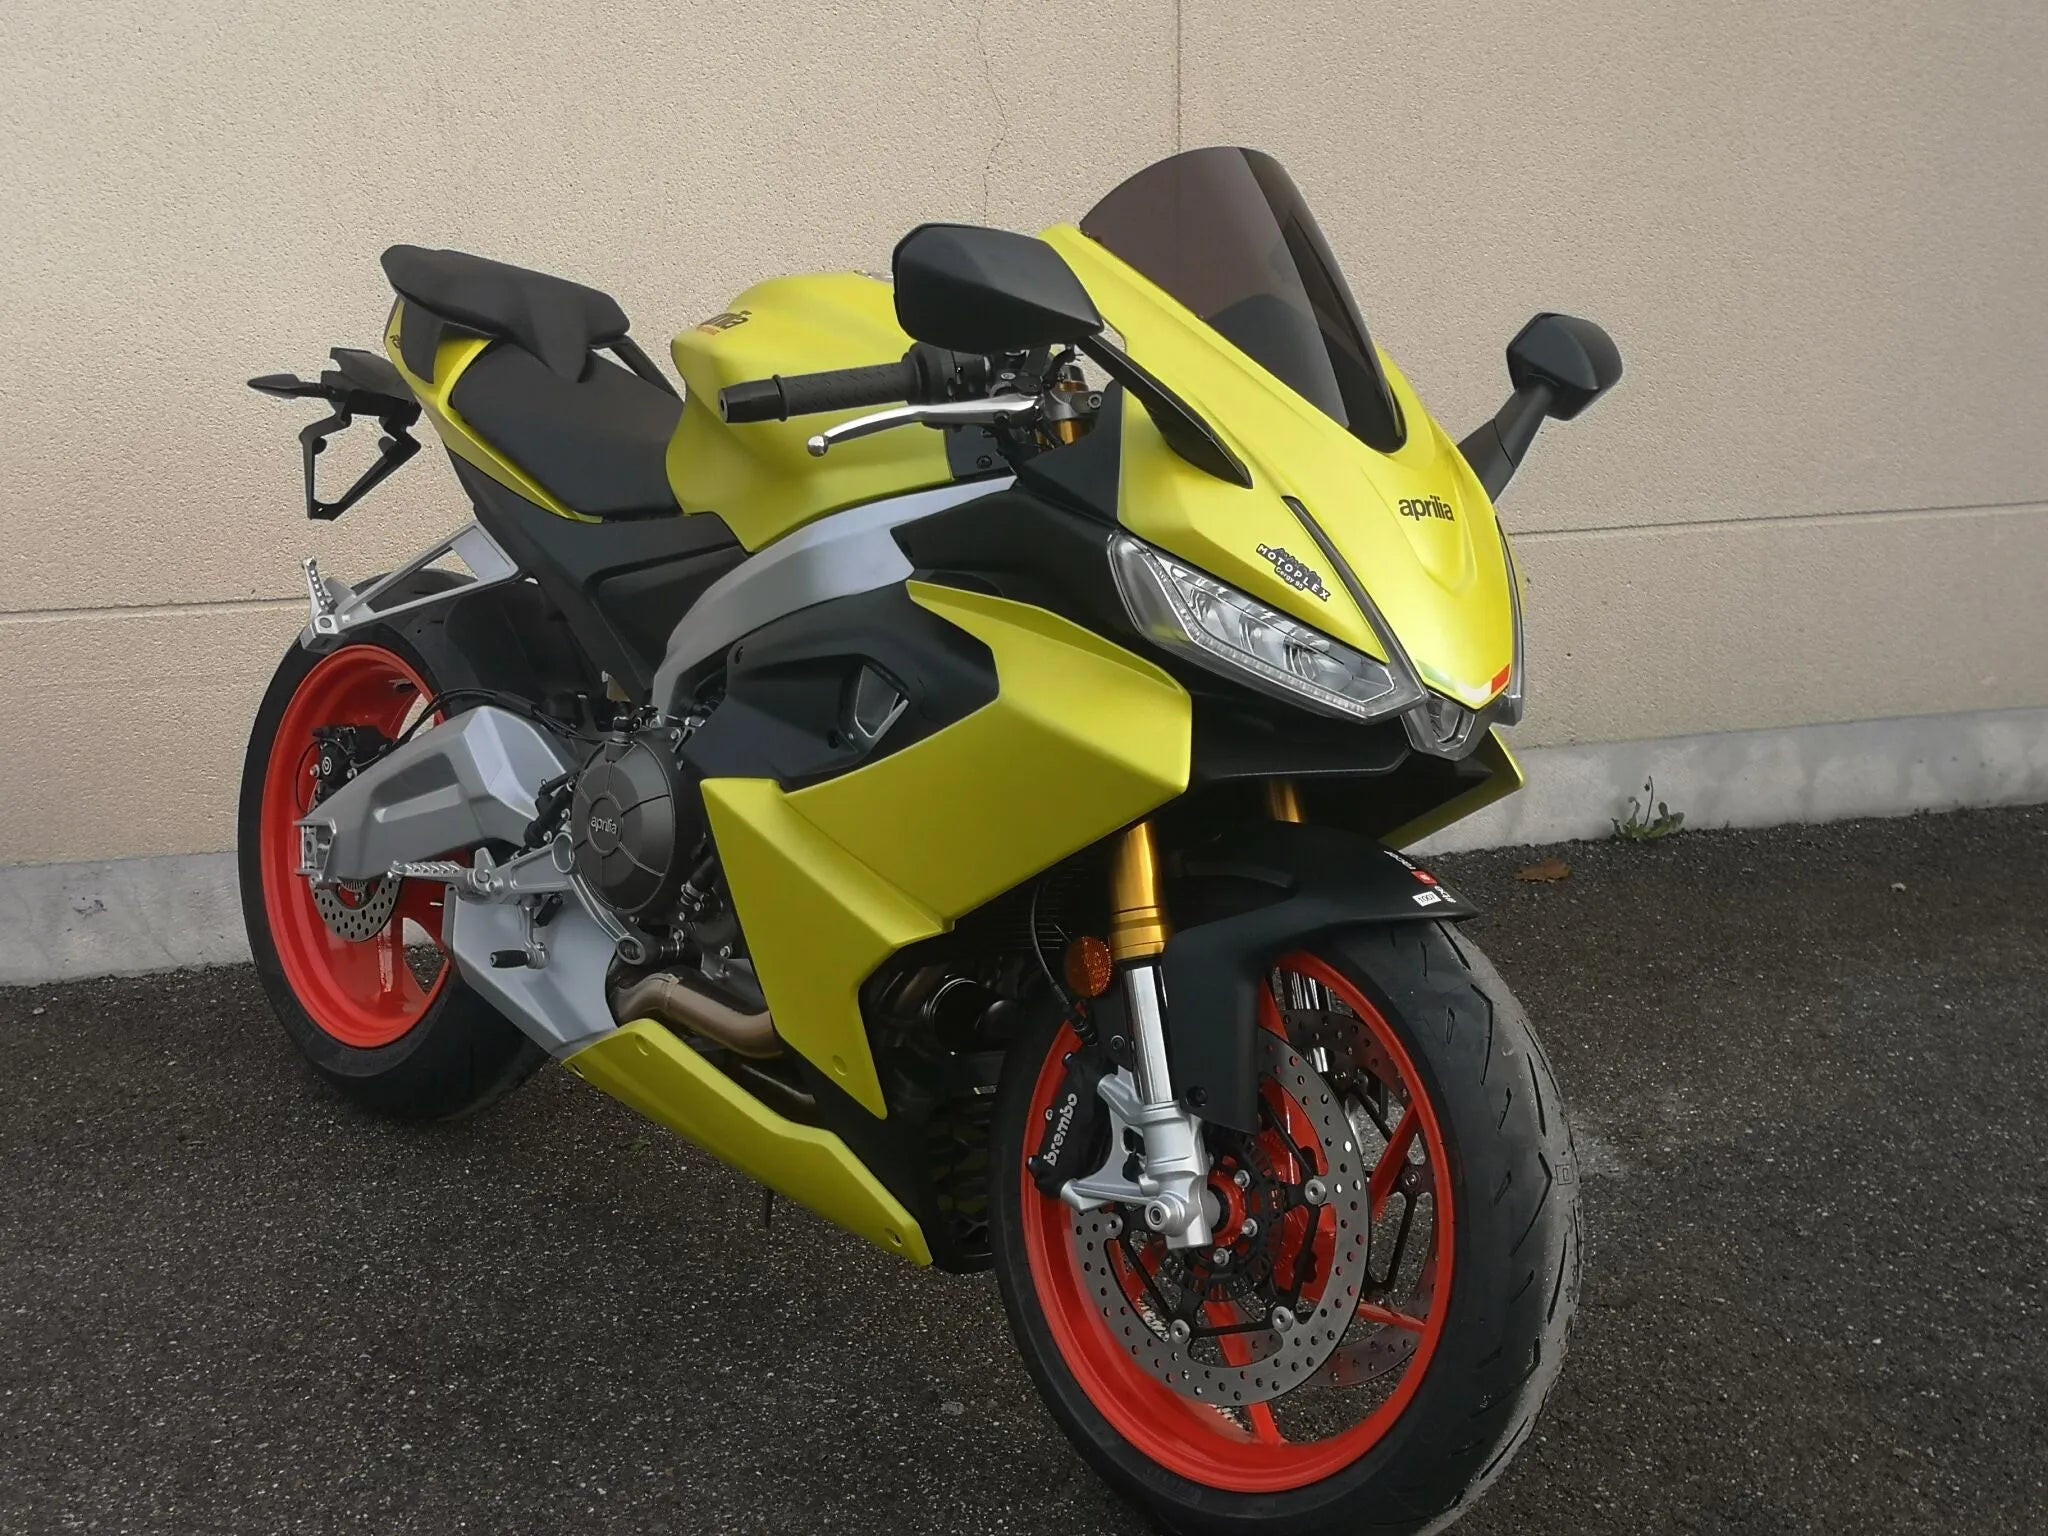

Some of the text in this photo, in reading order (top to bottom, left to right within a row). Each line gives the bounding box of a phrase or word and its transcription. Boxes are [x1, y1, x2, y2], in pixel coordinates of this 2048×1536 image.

[1398, 494, 1455, 521] aprilia
[1257, 545, 1329, 600] MOTOPLEX
[1043, 1093, 1078, 1167] brembo
